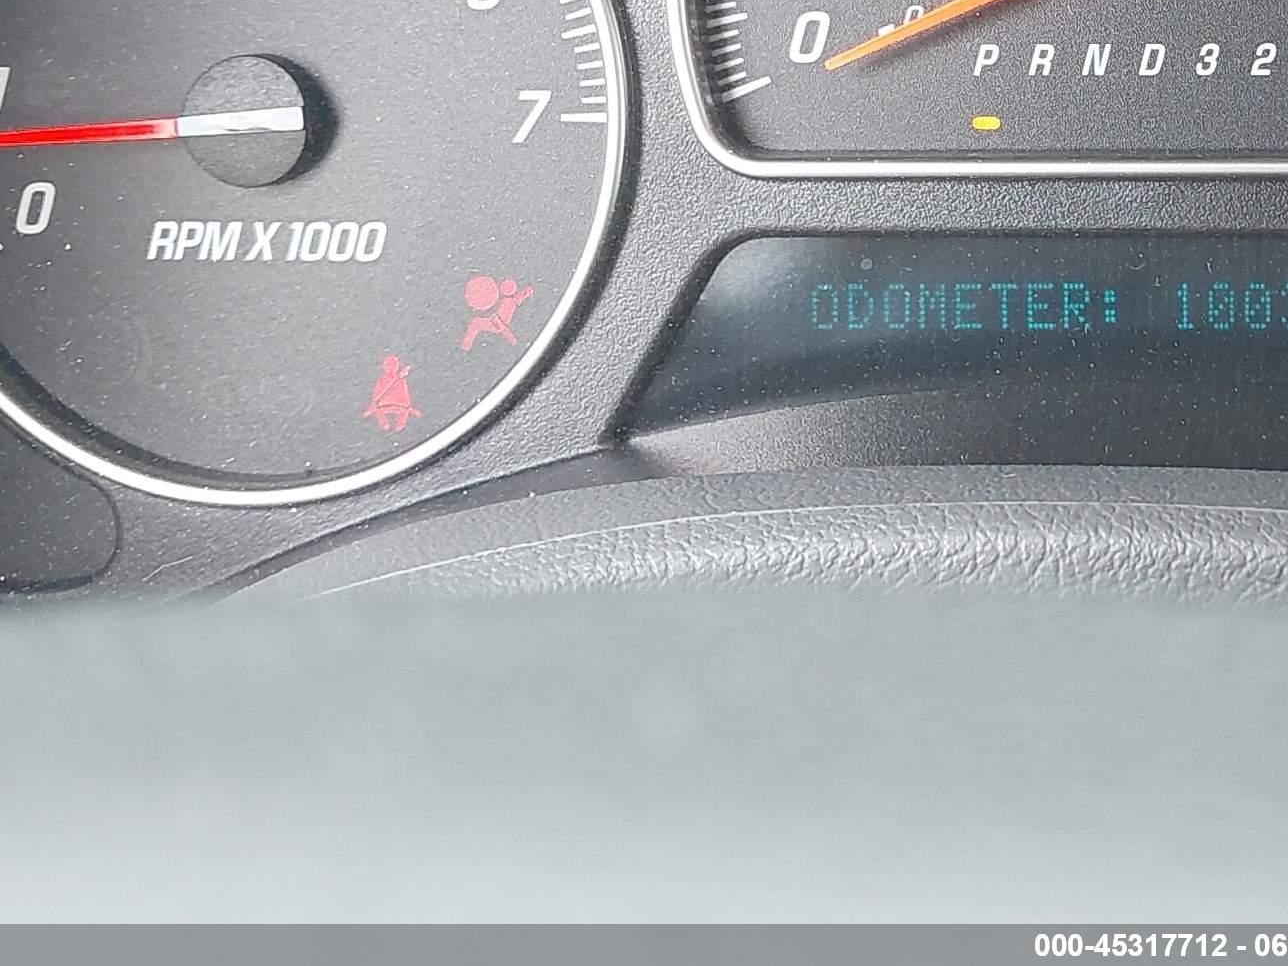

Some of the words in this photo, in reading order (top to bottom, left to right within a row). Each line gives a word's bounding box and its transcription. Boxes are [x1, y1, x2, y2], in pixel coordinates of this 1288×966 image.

[789, 11, 830, 64] 0
[973, 44, 1000, 76] P
[1028, 44, 1055, 76] R
[1082, 44, 1109, 76] N
[1138, 44, 1165, 76] D
[1195, 44, 1220, 76] 3
[1251, 44, 1277, 76] 2
[511, 90, 551, 143] 7
[15, 182, 56, 234] 0
[146, 220, 243, 262] RPM
[243, 221, 283, 262] X
[285, 221, 388, 262] 1000
[810, 283, 1119, 330] ODOMETER:
